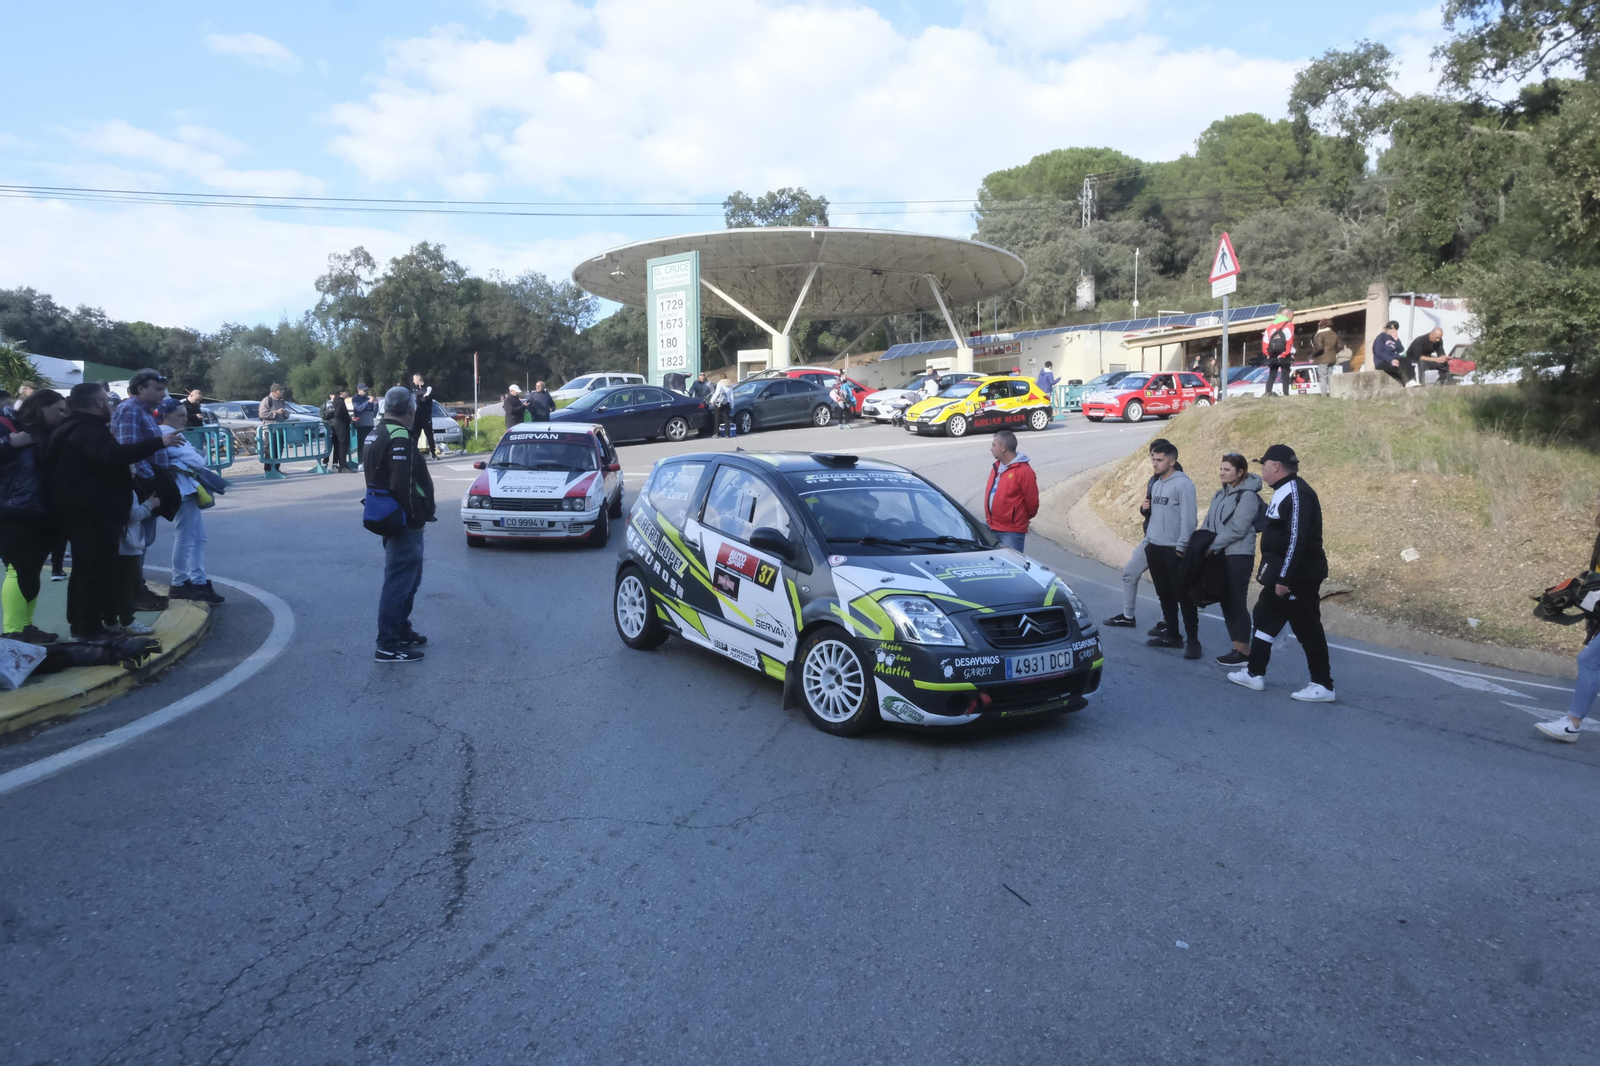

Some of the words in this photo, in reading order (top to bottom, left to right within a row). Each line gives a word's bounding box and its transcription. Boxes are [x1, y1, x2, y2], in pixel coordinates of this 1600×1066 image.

[654, 268, 662, 276] EL
[665, 262, 689, 274] CRUCE
[660, 299, 683, 311] 1.729
[660, 317, 683, 330] 1.673
[660, 337, 677, 349] 1.80
[661, 355, 683, 367] 1.823
[974, 417, 1001, 427] GRUAS
[1004, 414, 1026, 423] MATA
[510, 433, 558, 441] SERVAN
[675, 472, 696, 483] Zurera
[667, 489, 688, 500] Zurera
[506, 518, 517, 526] CO
[518, 518, 538, 527] 9994
[540, 519, 545, 527] V
[729, 549, 747, 563] AUTO
[727, 557, 745, 569] SPORT
[758, 564, 776, 586] 37
[755, 619, 787, 638] SERVAN
[880, 642, 902, 651] Mesón
[1072, 637, 1097, 651] DESAYUNOS
[955, 655, 1000, 667] DESAYUNOS
[1015, 656, 1045, 675] 4931
[1050, 650, 1072, 670] DCD
[873, 662, 910, 678] Martín
[963, 666, 994, 680] GAREY
